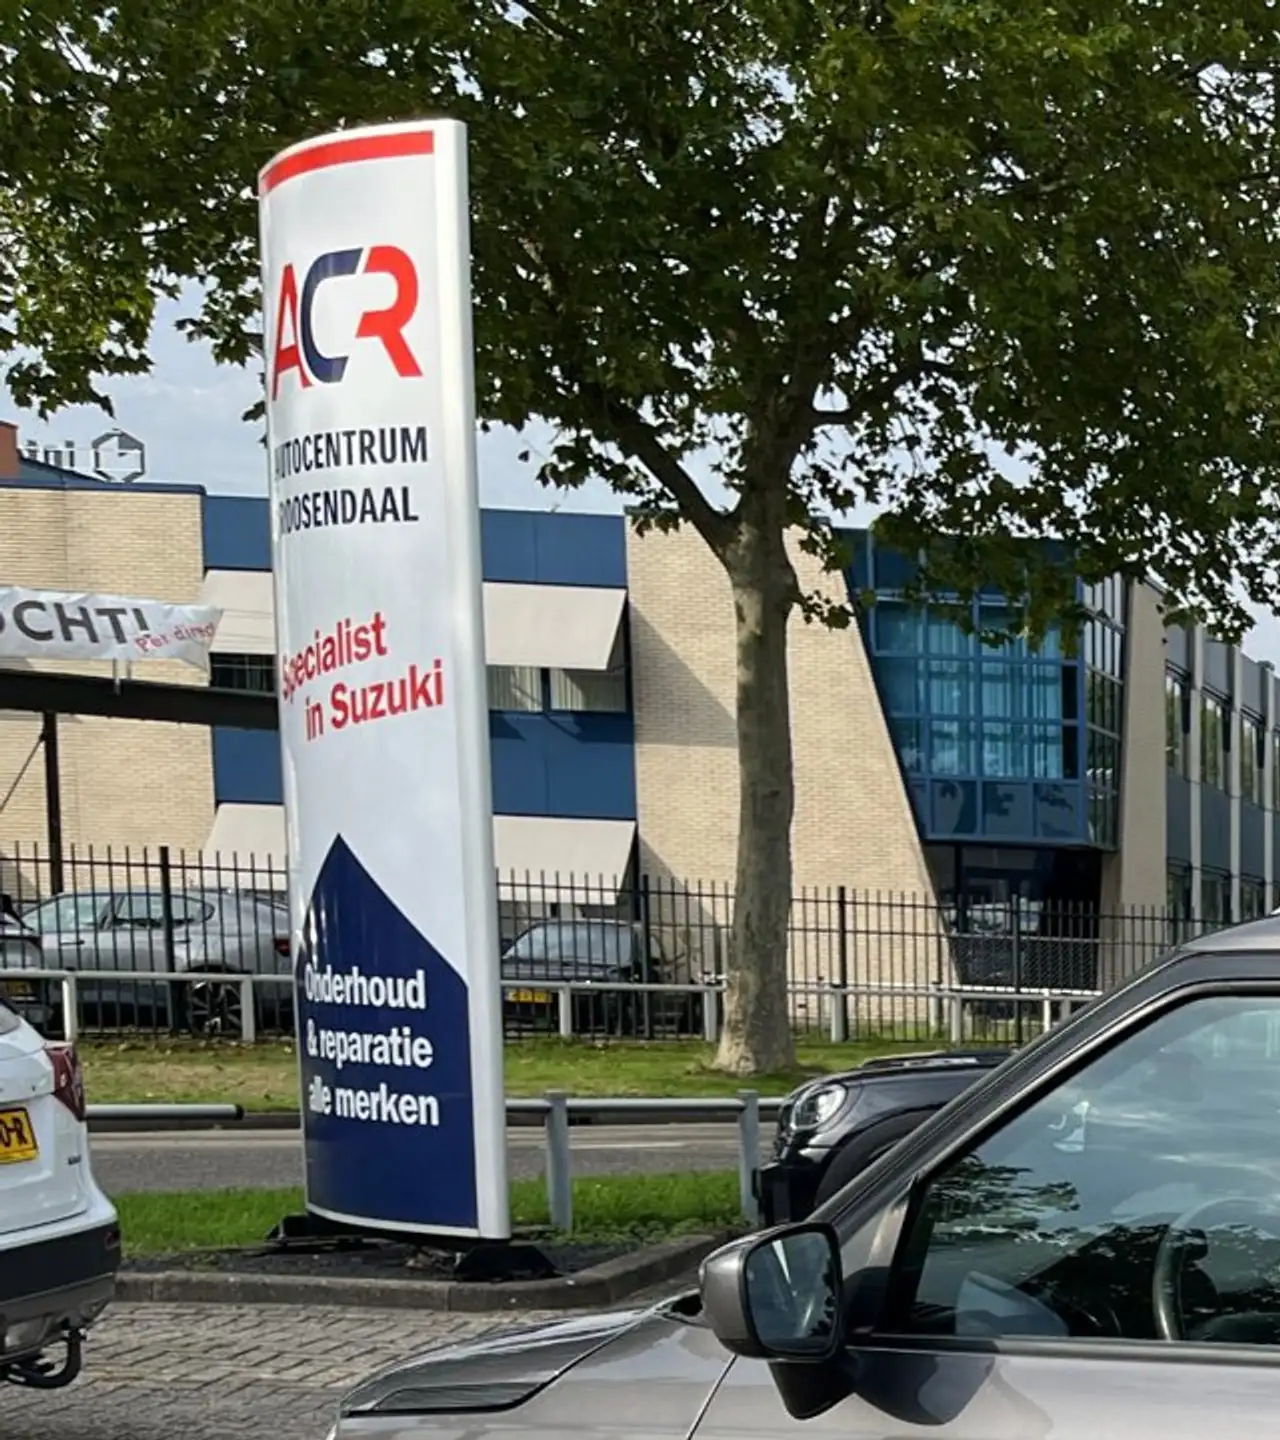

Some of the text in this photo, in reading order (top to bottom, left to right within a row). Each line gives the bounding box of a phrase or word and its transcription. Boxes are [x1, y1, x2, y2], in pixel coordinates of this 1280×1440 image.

[273, 246, 423, 400] ACR
[283, 611, 387, 704] Specialist
[305, 659, 444, 742] in Suzuki
[304, 962, 426, 1010] Onderhoud
[319, 1026, 434, 1070] reparatie
[308, 1075, 440, 1127] alle merken
